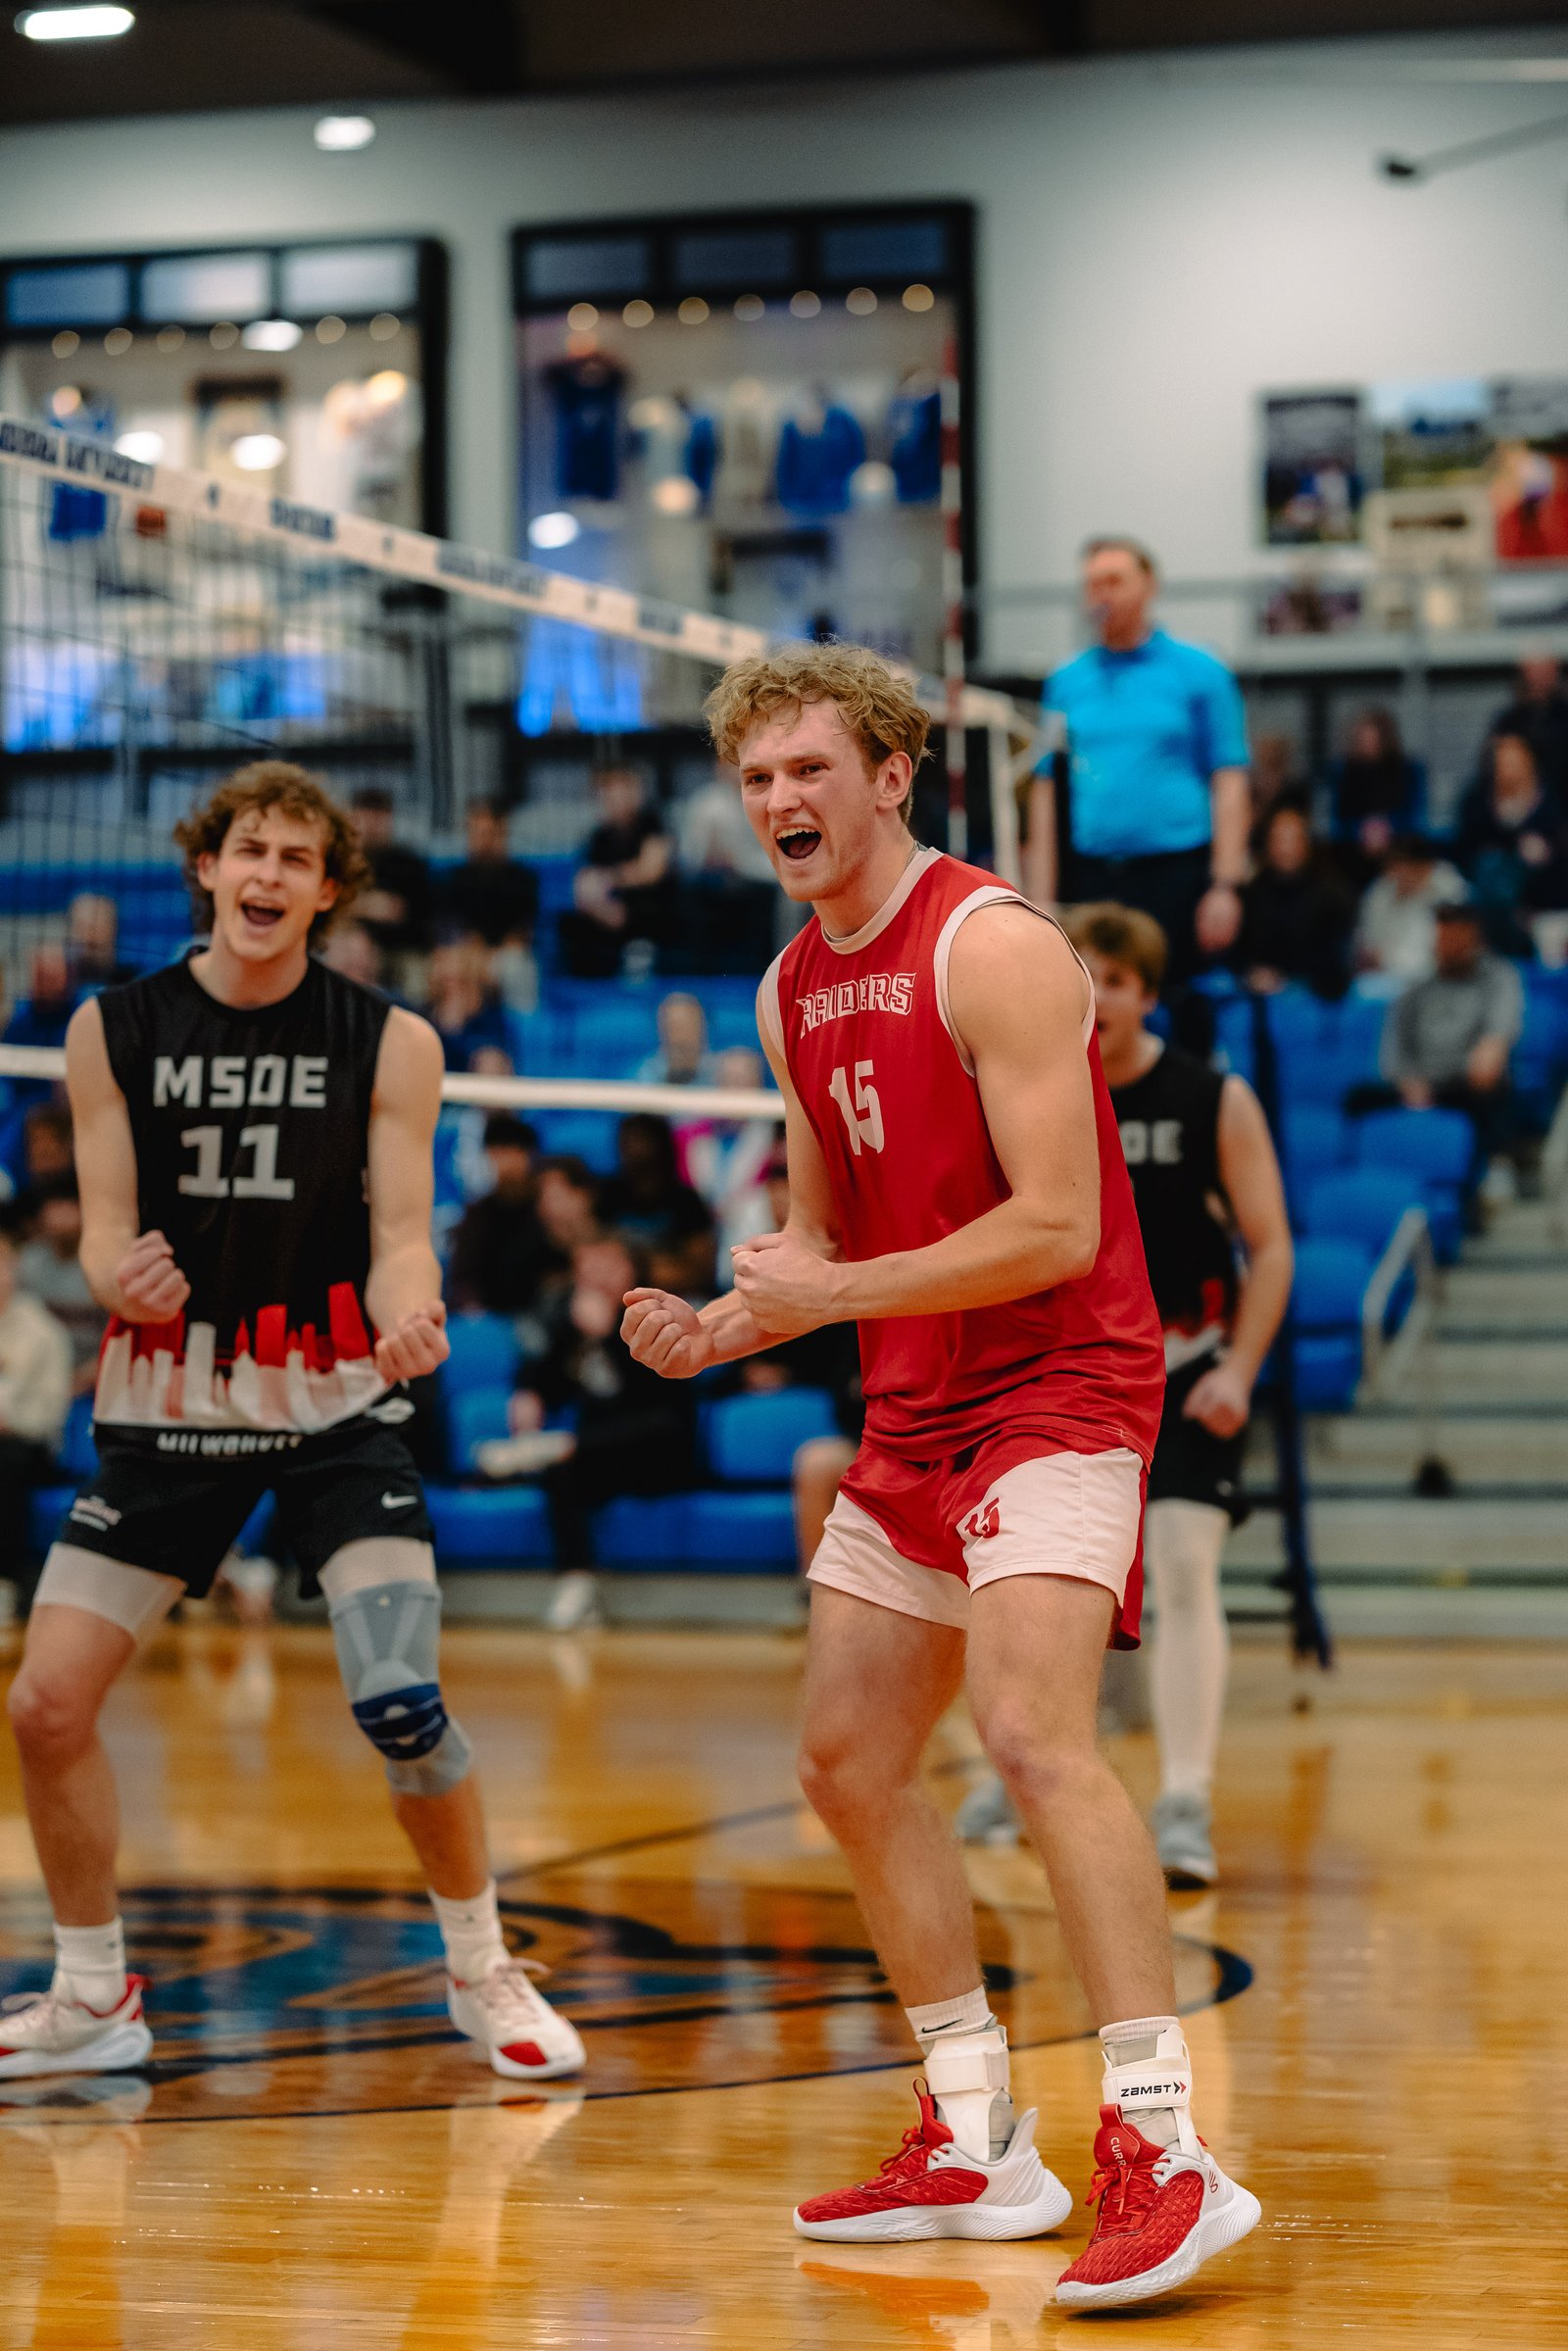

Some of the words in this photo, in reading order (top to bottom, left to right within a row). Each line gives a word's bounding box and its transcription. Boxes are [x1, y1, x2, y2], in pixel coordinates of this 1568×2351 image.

[153, 1053, 329, 1108] MSOE
[828, 1059, 885, 1156] 15
[177, 1124, 295, 1200] 11
